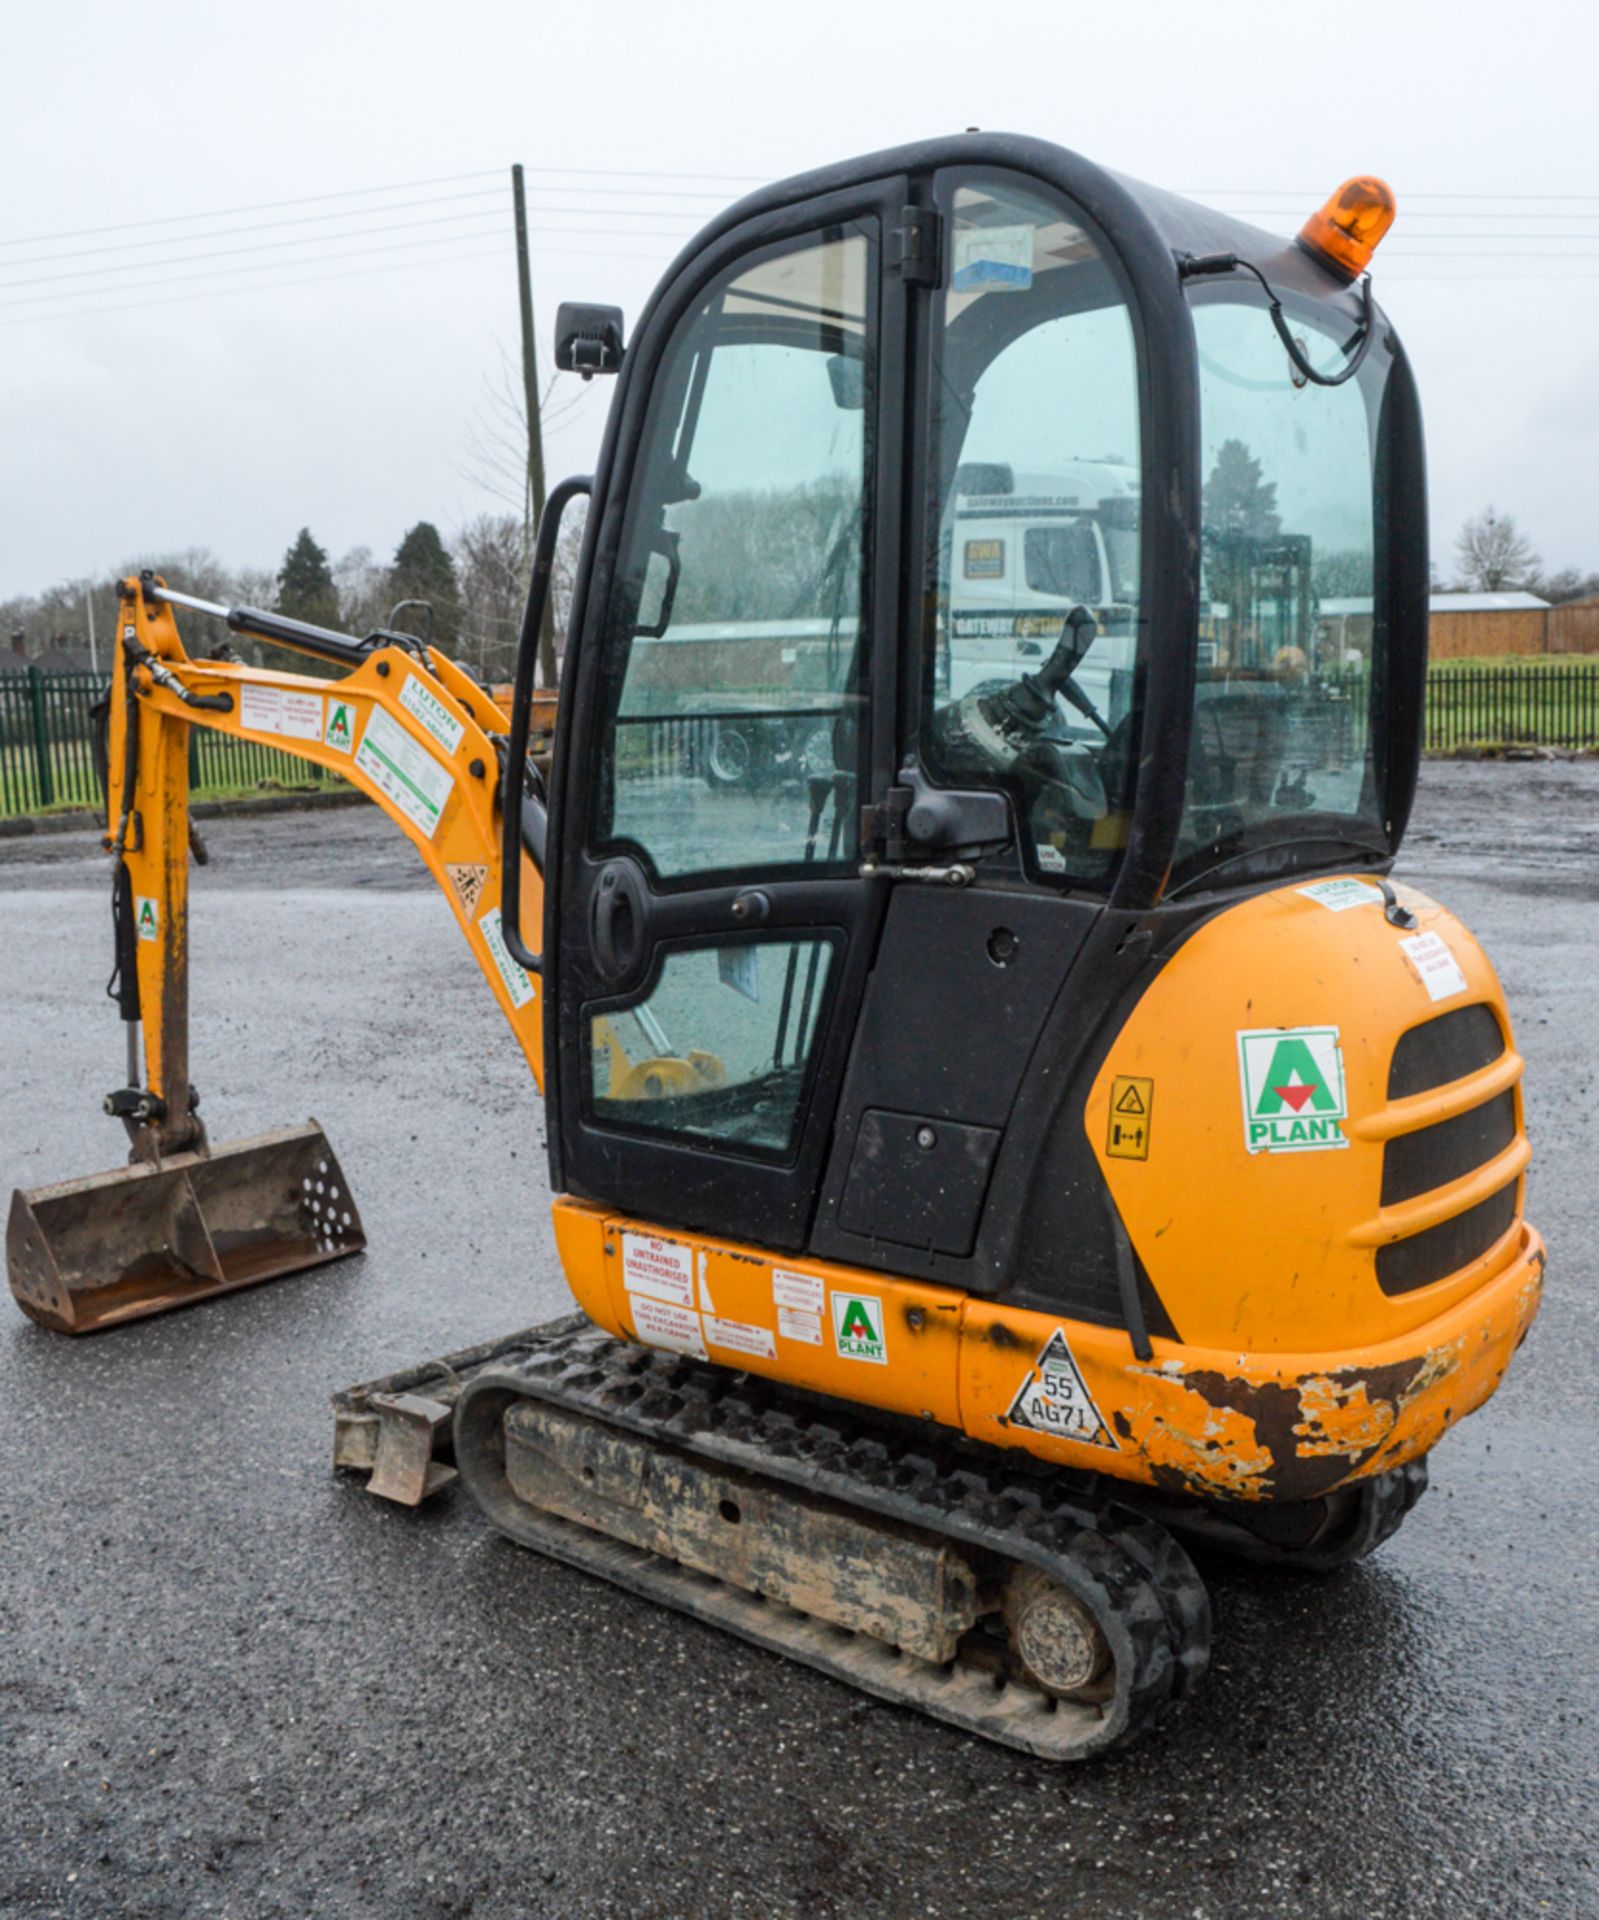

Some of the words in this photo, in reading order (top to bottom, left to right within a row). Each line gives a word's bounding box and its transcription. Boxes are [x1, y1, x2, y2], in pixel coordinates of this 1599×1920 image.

[412, 681, 458, 731] LUTON
[1255, 1038, 1338, 1115] A
[1249, 1119, 1341, 1144] PLANT
[633, 1247, 681, 1270] UNTRAINED
[650, 1240, 664, 1252] NO
[626, 1258, 689, 1284] UNAUTHORISED
[841, 1299, 879, 1342] A
[838, 1339, 883, 1357] PLANT
[1045, 1373, 1073, 1399] 55
